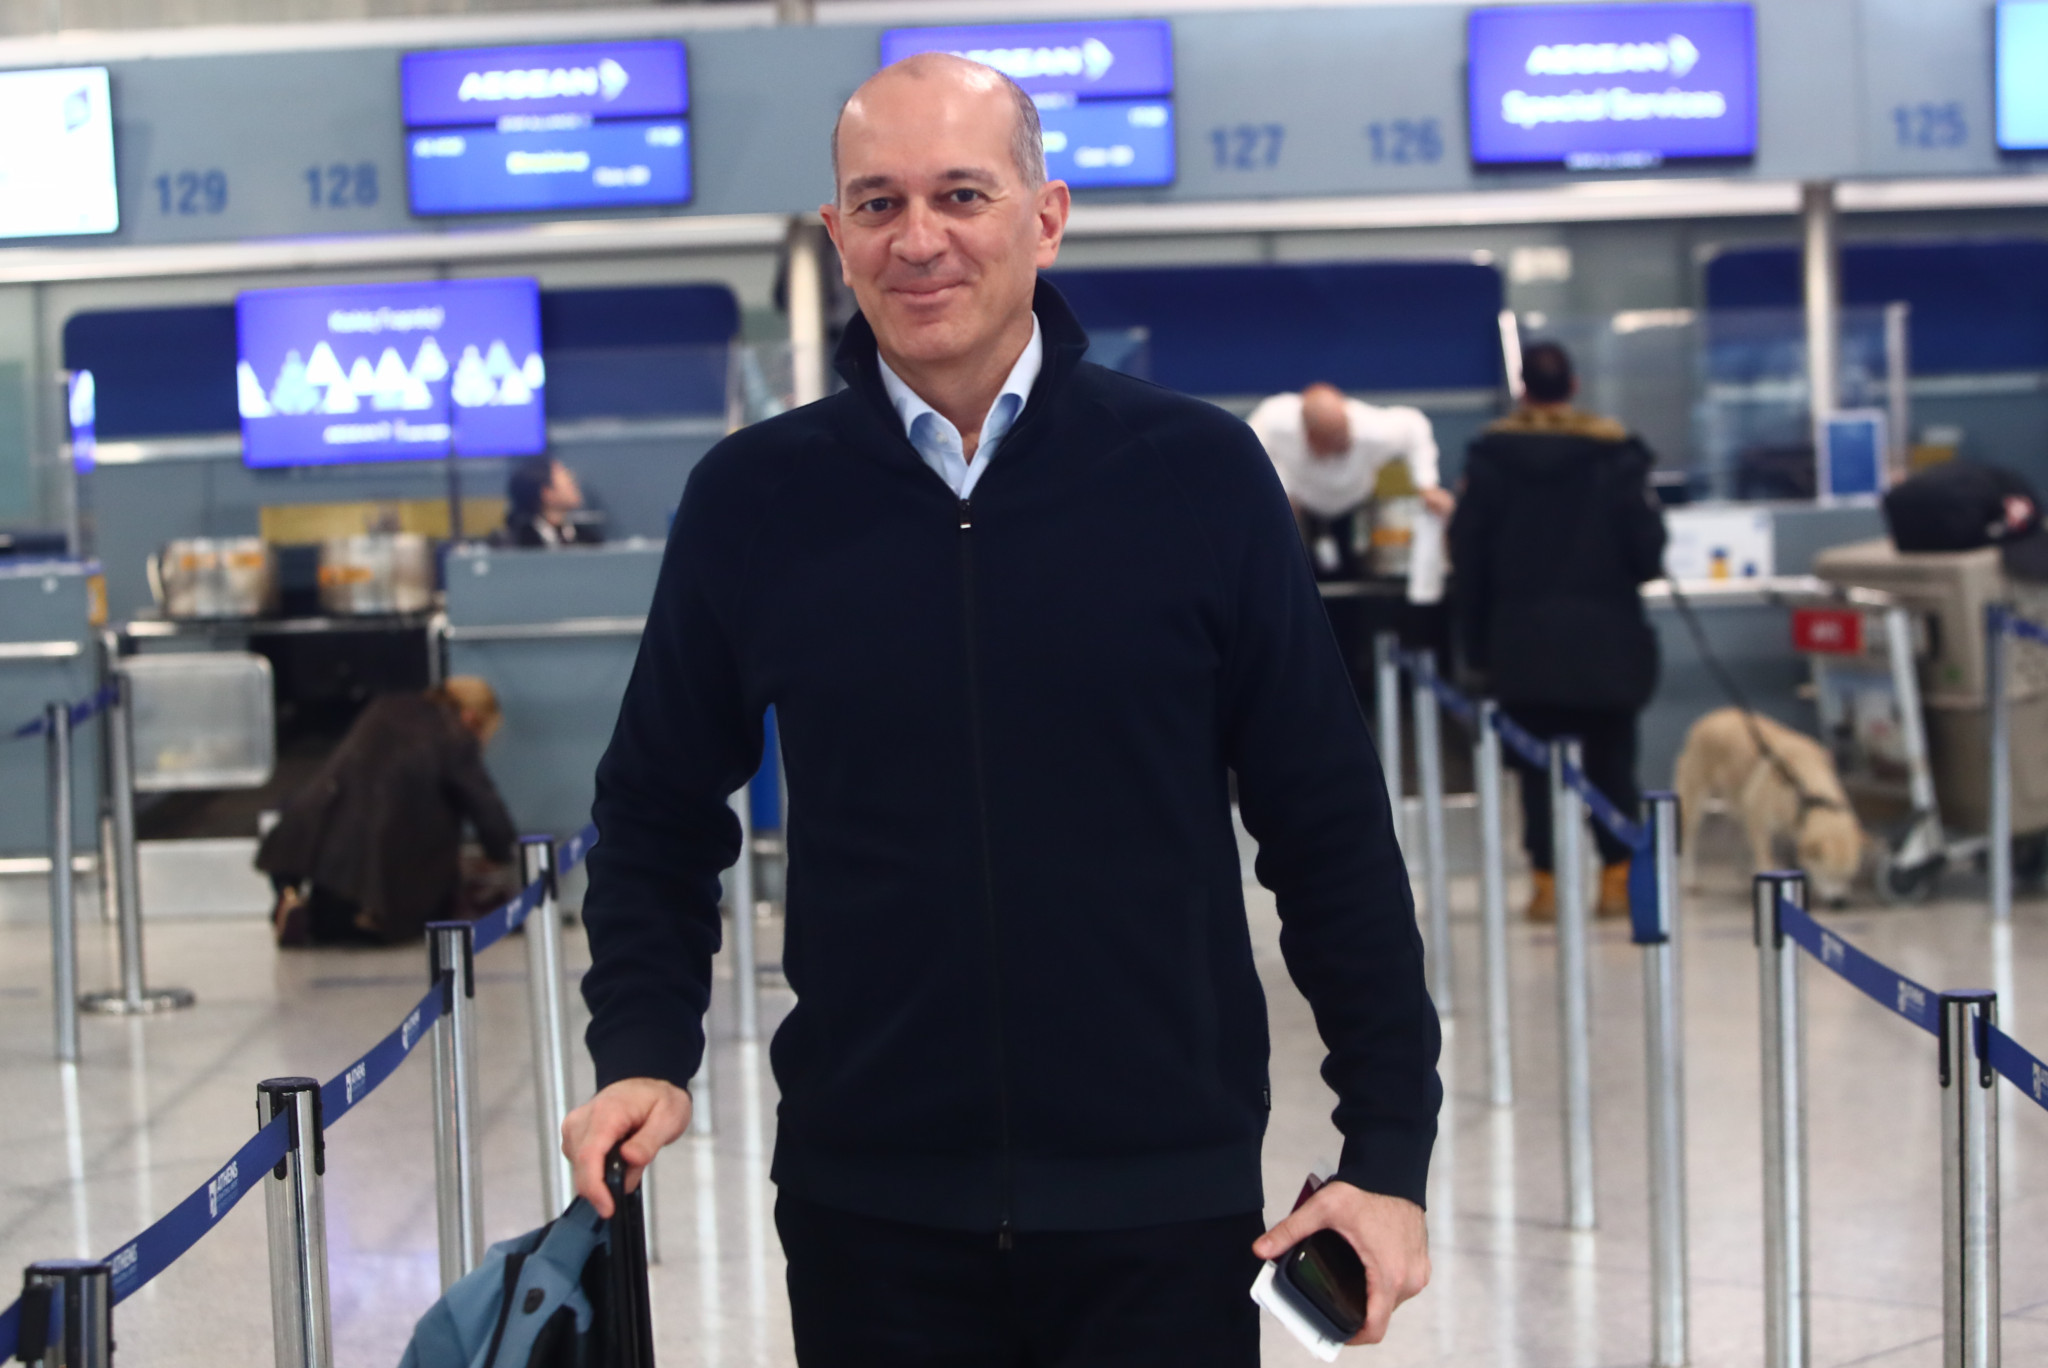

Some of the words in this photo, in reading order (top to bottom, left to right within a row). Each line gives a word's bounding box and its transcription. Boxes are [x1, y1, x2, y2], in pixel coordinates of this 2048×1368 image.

[1525, 42, 1669, 76] AEGEAN
[458, 67, 599, 101] AEGEAN
[1209, 122, 1285, 170] 127
[1366, 118, 1443, 165] 126
[1892, 102, 1967, 148] 125
[154, 168, 228, 215] 129
[305, 162, 379, 209] 128
[217, 1160, 239, 1191] ATHENS
